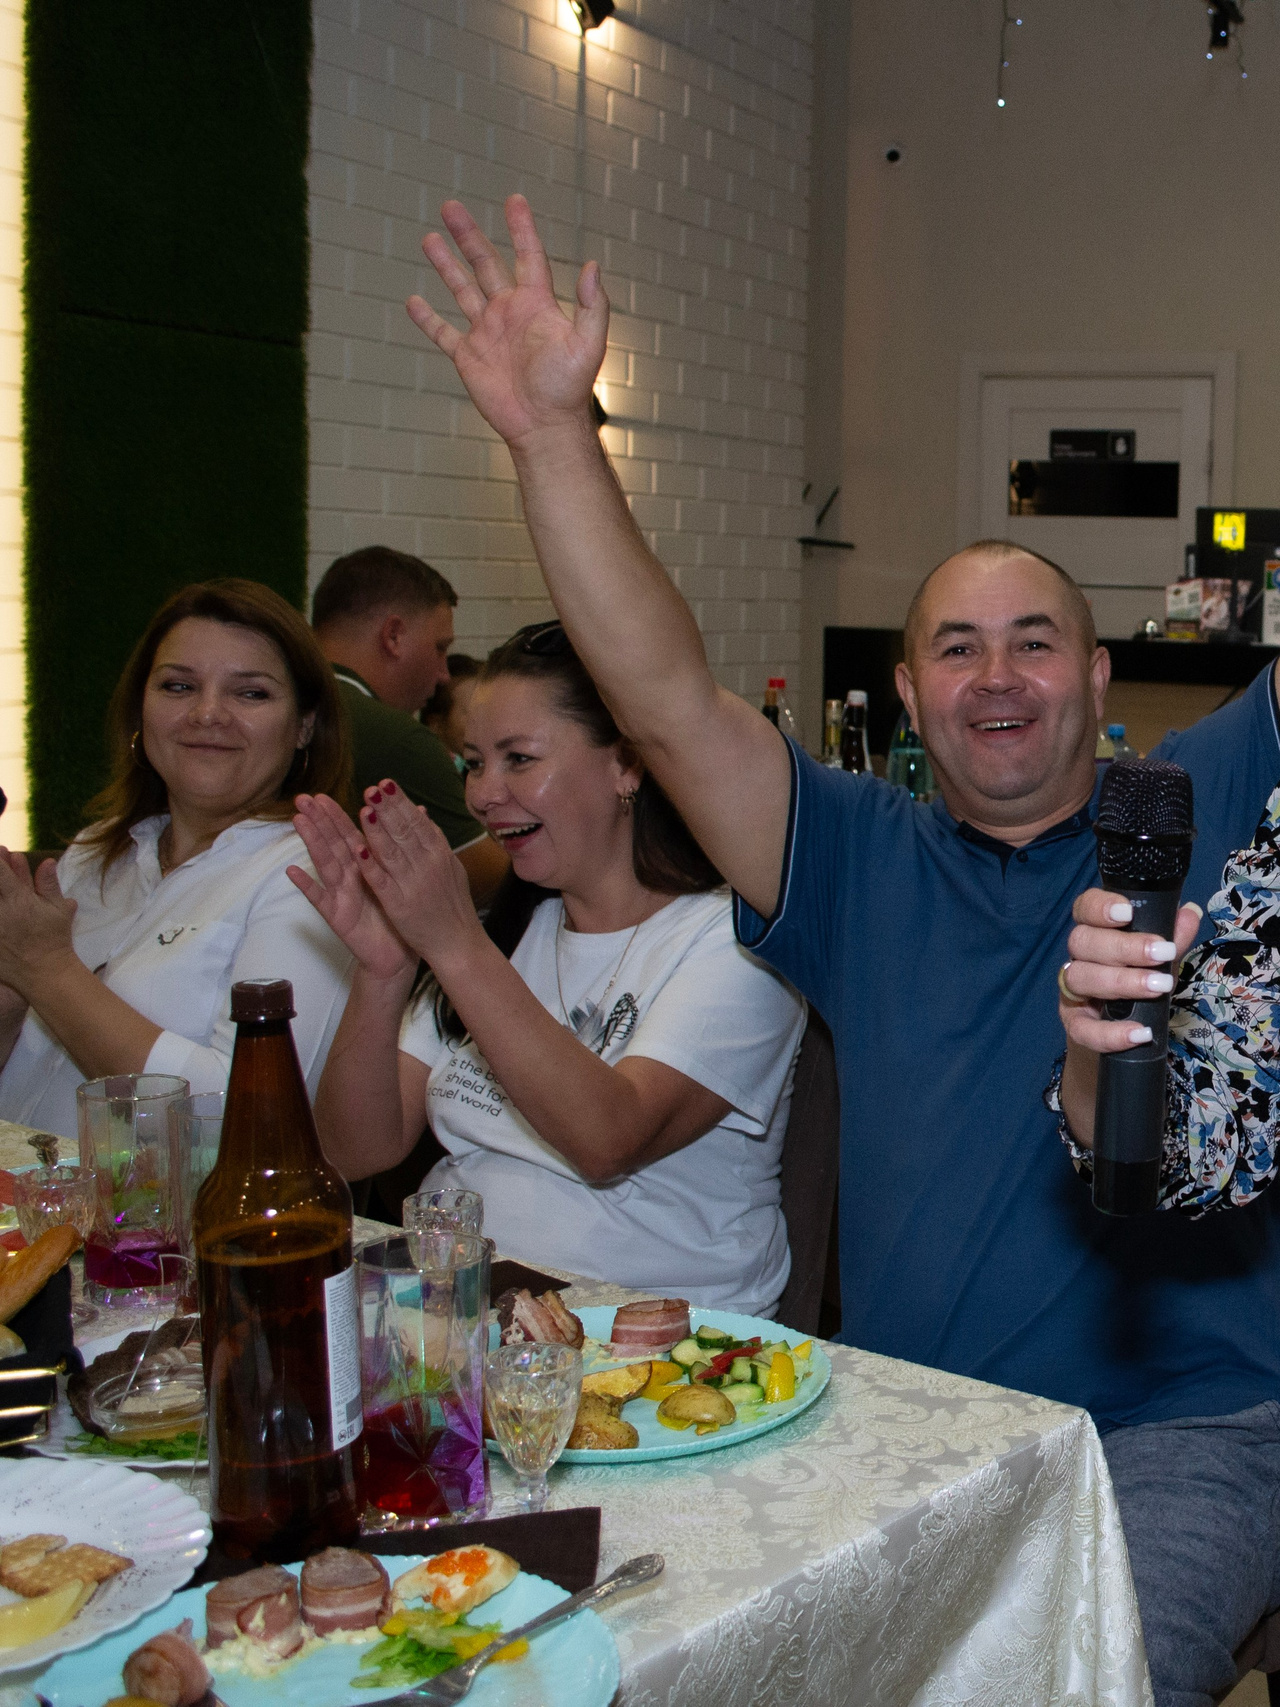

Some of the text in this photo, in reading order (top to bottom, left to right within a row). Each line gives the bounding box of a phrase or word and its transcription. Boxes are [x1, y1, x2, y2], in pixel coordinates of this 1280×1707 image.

[459, 1060, 483, 1076] the
[431, 1087, 503, 1117] cruel world
[445, 1071, 508, 1104] shield for
